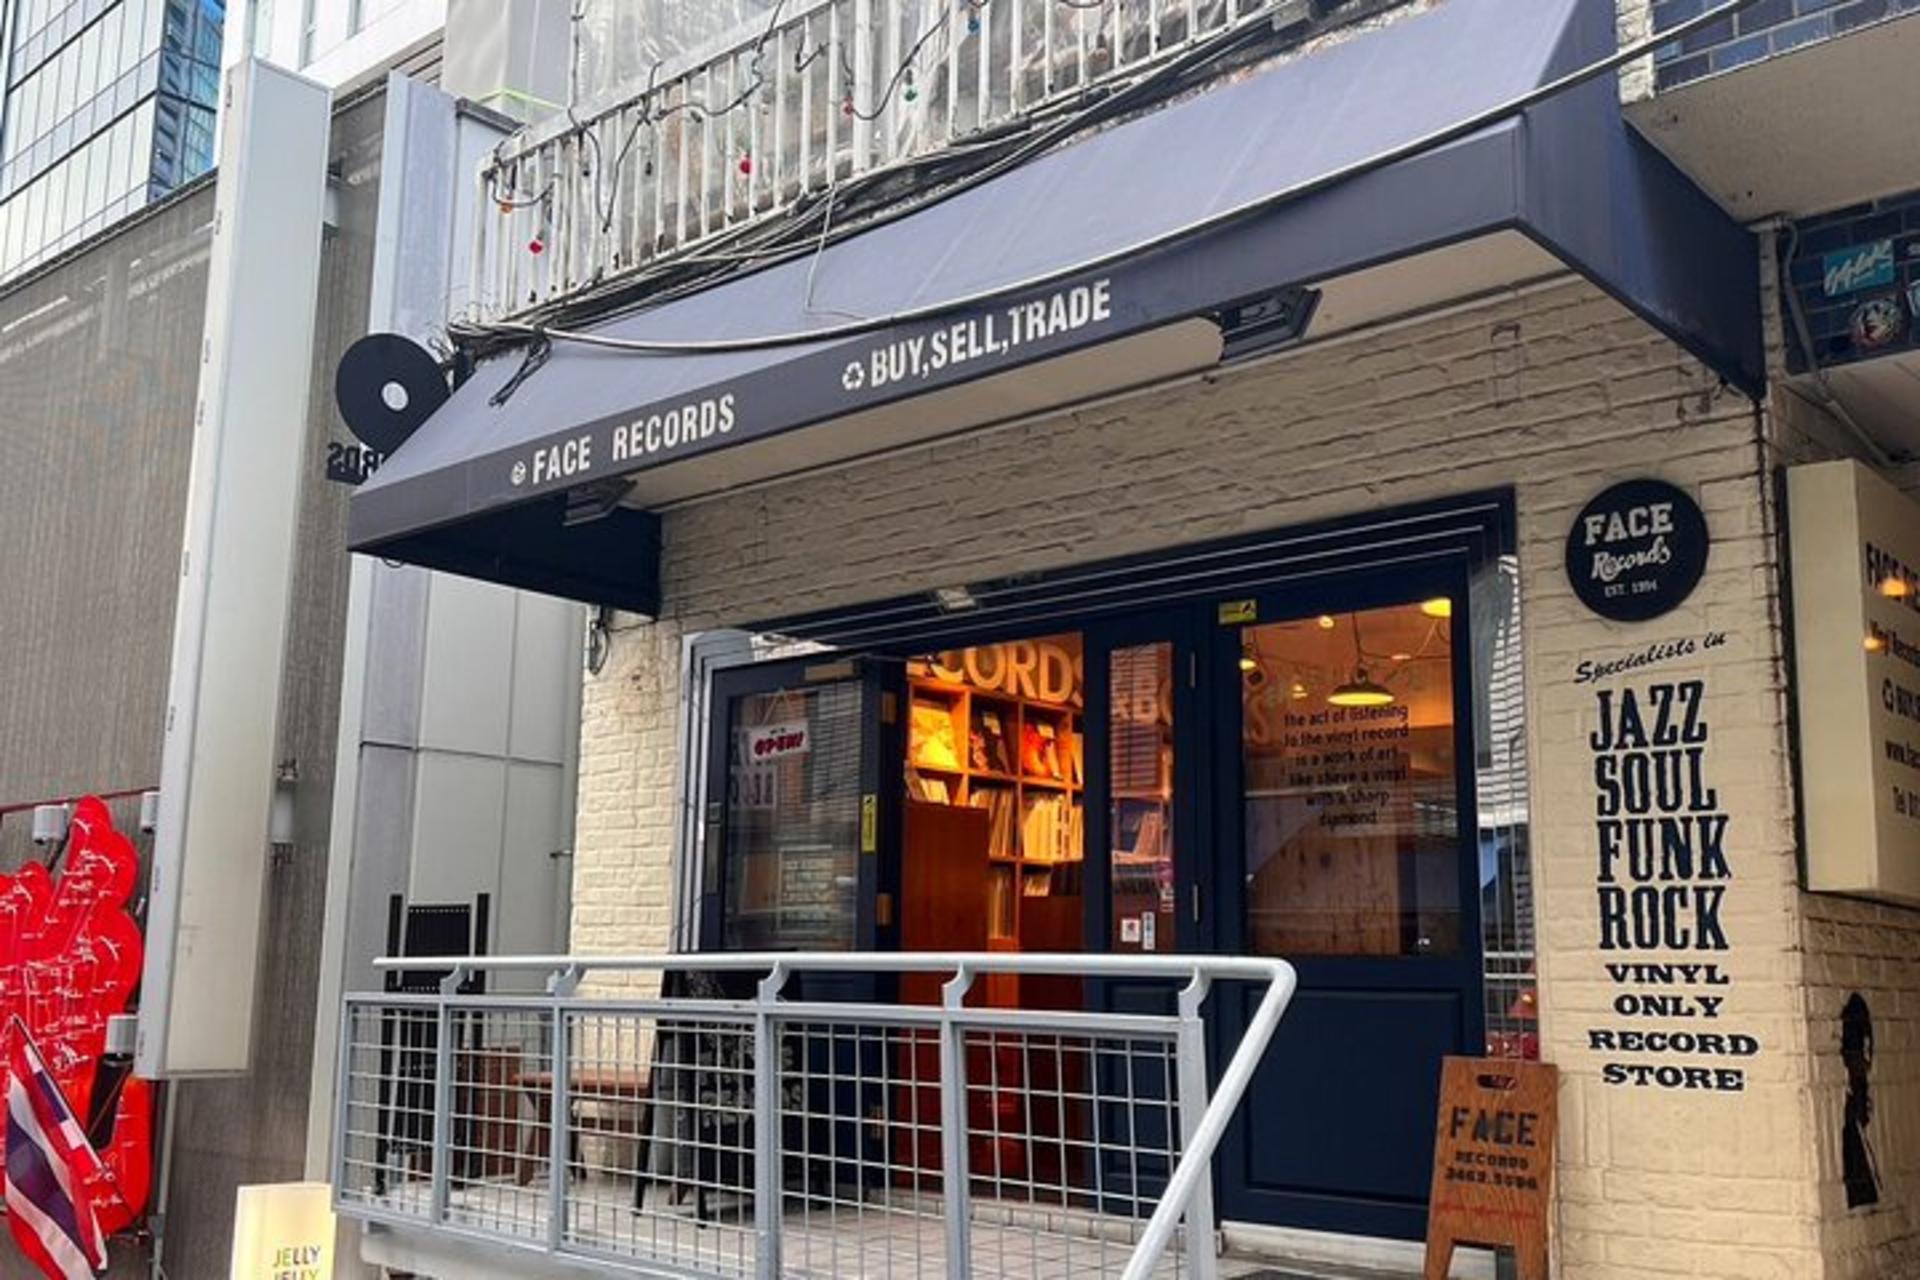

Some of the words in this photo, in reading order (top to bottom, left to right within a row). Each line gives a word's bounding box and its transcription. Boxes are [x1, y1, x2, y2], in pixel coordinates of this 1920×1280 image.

[532, 436, 592, 484] FACE
[612, 394, 735, 462] RECORDS
[1584, 503, 1674, 545] FACE
[1591, 535, 1671, 582] Records
[1573, 638, 1696, 685] Specialists
[1703, 631, 1726, 649] in
[1362, 723, 1408, 741] record
[1590, 680, 1707, 751] JAZZ
[1595, 747, 1717, 816] SOUL
[1597, 814, 1732, 882] FUNK
[1597, 885, 1729, 950] ROCK
[1604, 963, 1729, 985] VINYL
[1613, 993, 1723, 1018] ONLY
[1588, 1029, 1759, 1056] RECORD
[1602, 1062, 1744, 1092] STORE
[1450, 1106, 1538, 1147] FACE
[1456, 1151, 1529, 1170] RECORDS
[272, 1245, 321, 1268] JELLY
